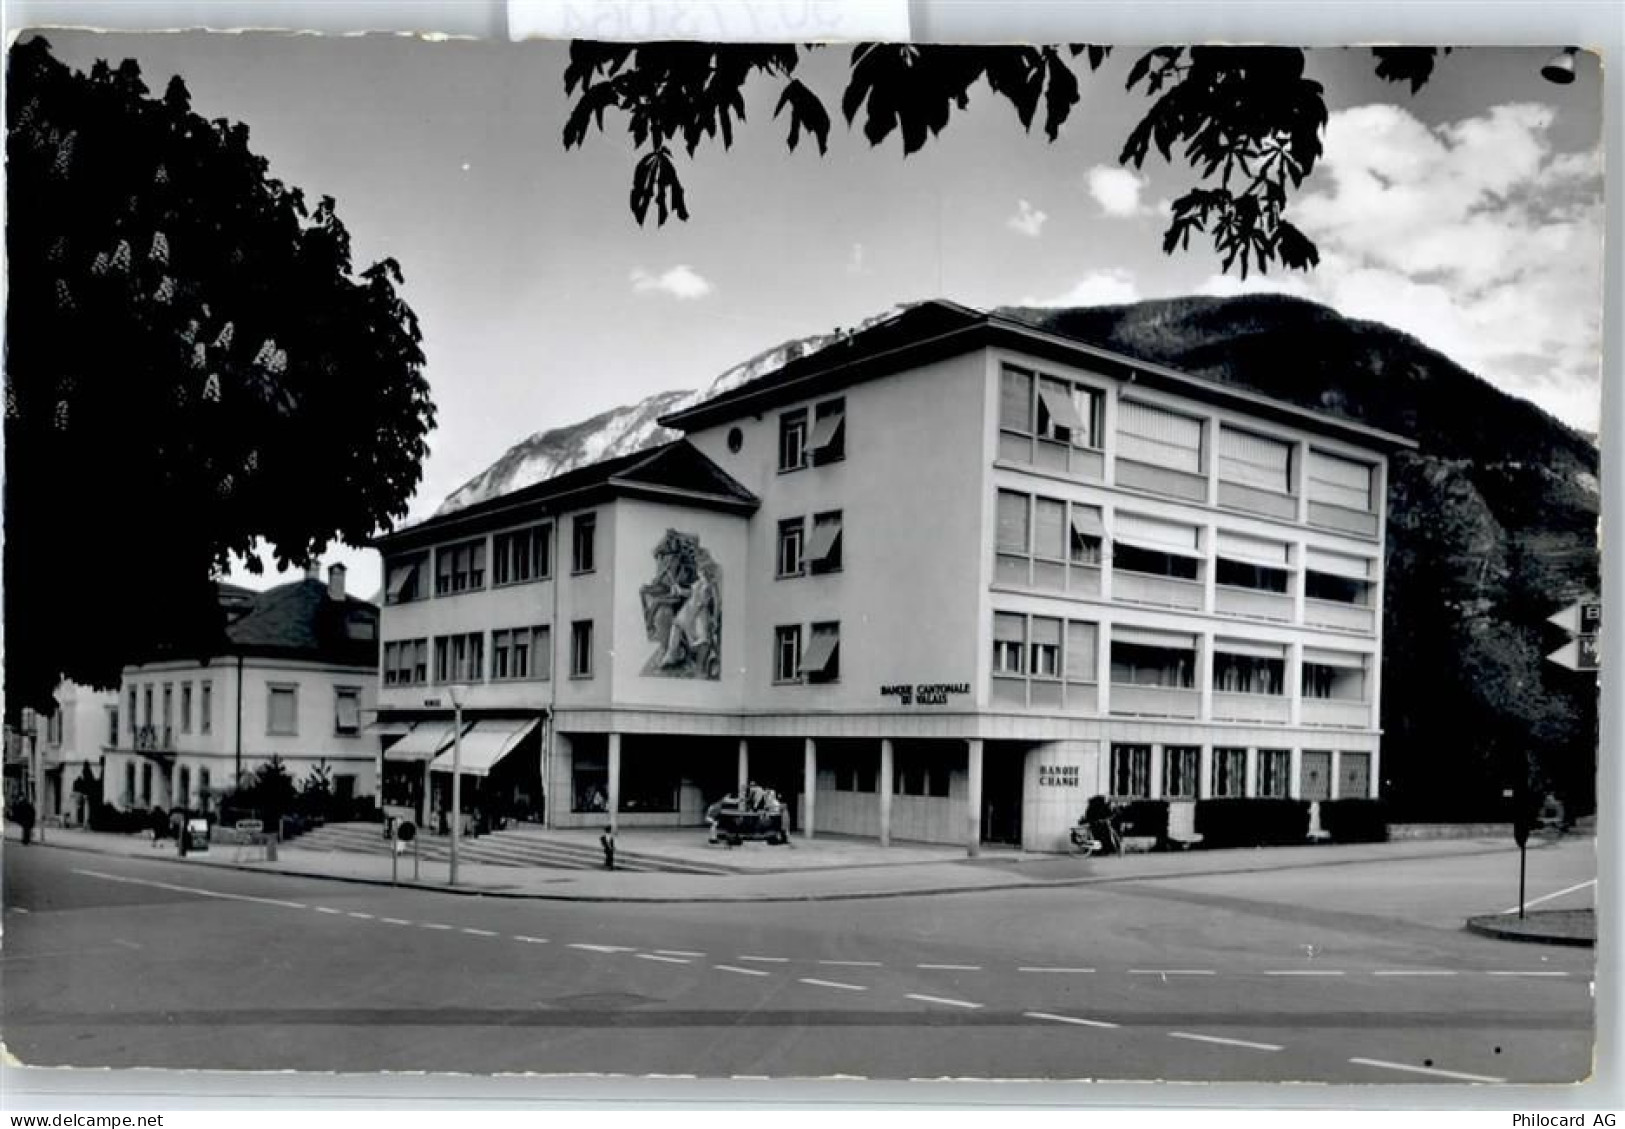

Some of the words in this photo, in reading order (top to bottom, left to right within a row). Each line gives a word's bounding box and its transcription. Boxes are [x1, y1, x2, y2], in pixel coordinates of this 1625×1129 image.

[880, 684, 913, 696] BANQUE
[916, 683, 970, 694] CANTONALE
[916, 694, 948, 705] VALAIS
[1039, 765, 1079, 775] BANQUE
[1039, 777, 1079, 787] CHANGE
